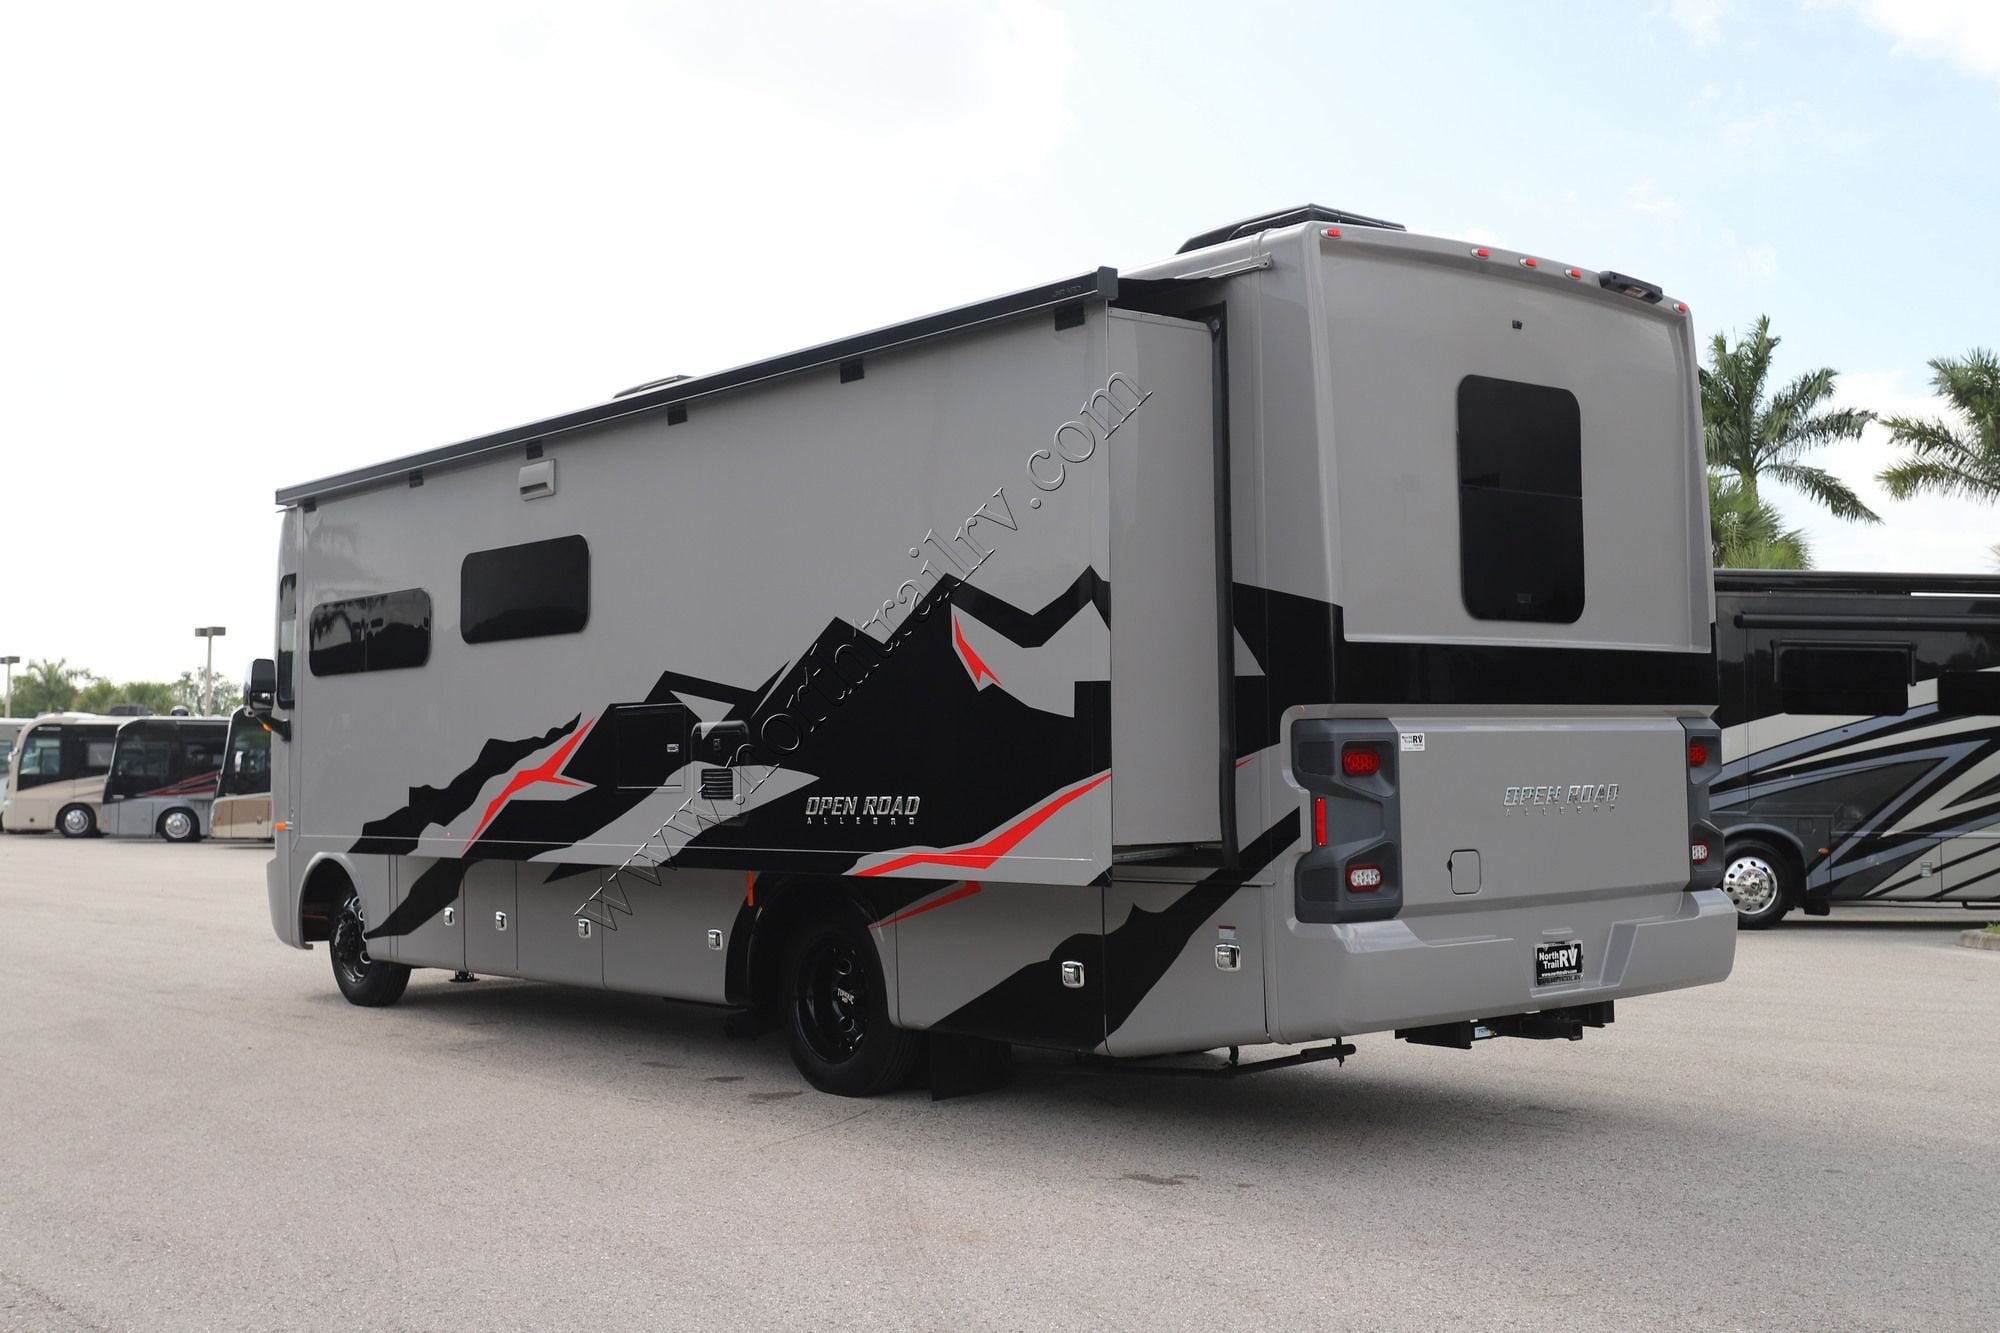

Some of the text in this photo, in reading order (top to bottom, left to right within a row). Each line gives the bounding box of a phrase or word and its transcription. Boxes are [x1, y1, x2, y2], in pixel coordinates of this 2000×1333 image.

[1503, 783, 1620, 806] OPEN ROAD
[805, 795, 921, 816] OPEN ROAD
[806, 816, 914, 825] ALLEGRO
[1539, 948, 1578, 968] North RV
[1543, 959, 1560, 970] Trail
